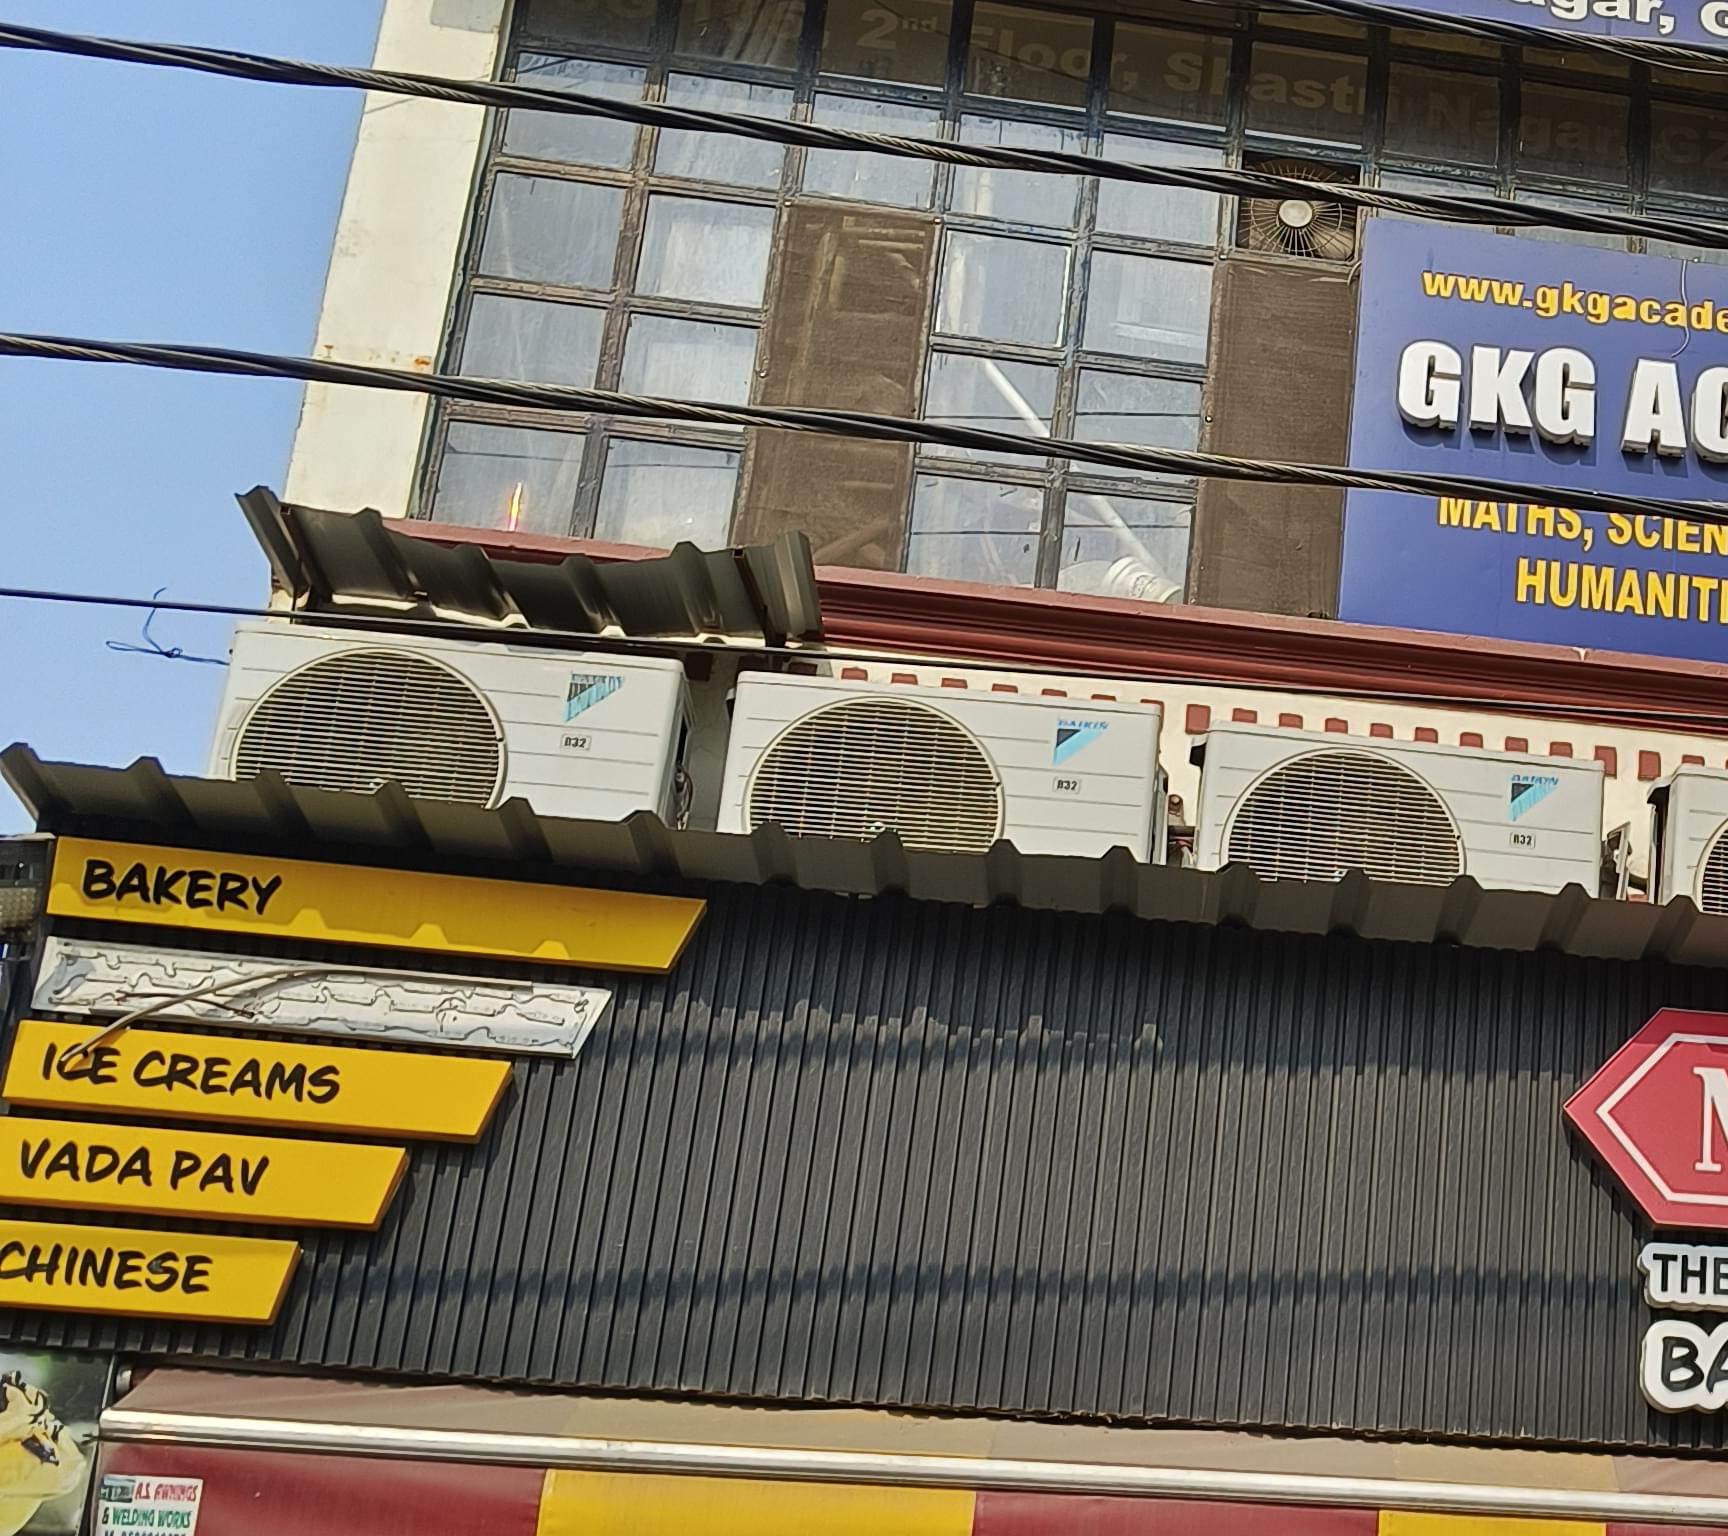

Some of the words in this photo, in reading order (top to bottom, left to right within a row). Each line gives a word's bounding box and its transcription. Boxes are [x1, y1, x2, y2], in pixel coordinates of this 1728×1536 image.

[1397, 338, 1597, 445] GKG
[81, 857, 282, 917] BAKERY
[133, 1050, 341, 1105] CREAMS
[20, 1138, 154, 1188] VADA
[170, 1149, 270, 1195] PAV
[0, 1241, 214, 1294] CHINESE
[112, 1507, 155, 1526] WELDING
[158, 1510, 192, 1528] WORKS
